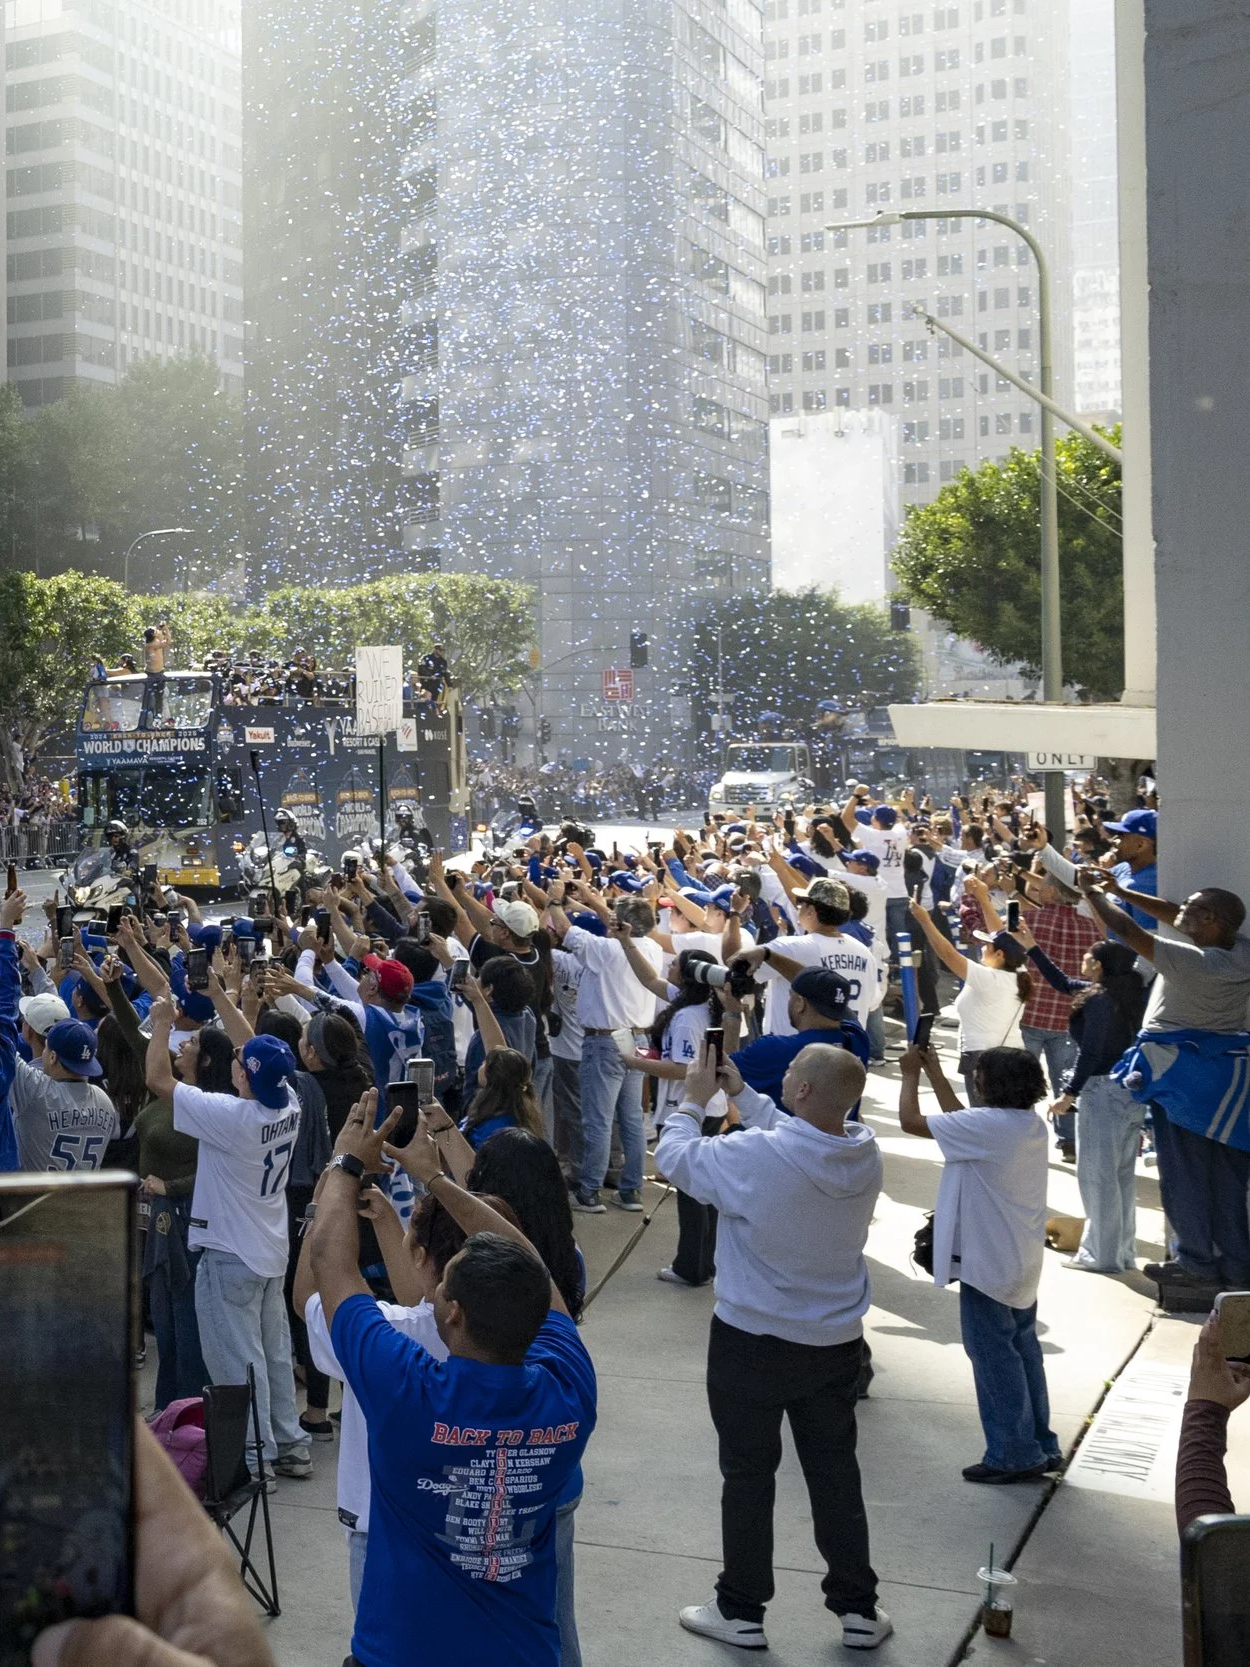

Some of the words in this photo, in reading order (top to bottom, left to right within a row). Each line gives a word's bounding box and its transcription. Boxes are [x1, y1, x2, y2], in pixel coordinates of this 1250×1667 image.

[358, 677, 397, 703] RUINED
[248, 731, 270, 740] Yakult
[343, 737, 362, 746] RESORT
[83, 741, 122, 754] WORLD
[136, 738, 206, 752] CHAMPIONS
[1036, 752, 1085, 765] ONLY
[821, 954, 868, 973] KERSHAW
[834, 988, 846, 1004] LA
[81, 1044, 91, 1060] LA
[682, 1040, 695, 1058] LA
[50, 1132, 105, 1171] 55
[260, 1140, 292, 1197] 17
[431, 1422, 491, 1446] BACK
[496, 1430, 524, 1446] TO
[526, 1421, 579, 1446] BACK
[486, 1448, 518, 1458] TYLER
[519, 1448, 556, 1457] GLASNOW
[470, 1458, 514, 1468] CLAYTON
[515, 1457, 551, 1467] KERSHAW
[488, 1475, 538, 1486] CASPARIUS
[462, 1491, 482, 1500] ANDY
[455, 1498, 479, 1508] BLAKE
[445, 1515, 460, 1524] BEN
[468, 1527, 485, 1535] WILL
